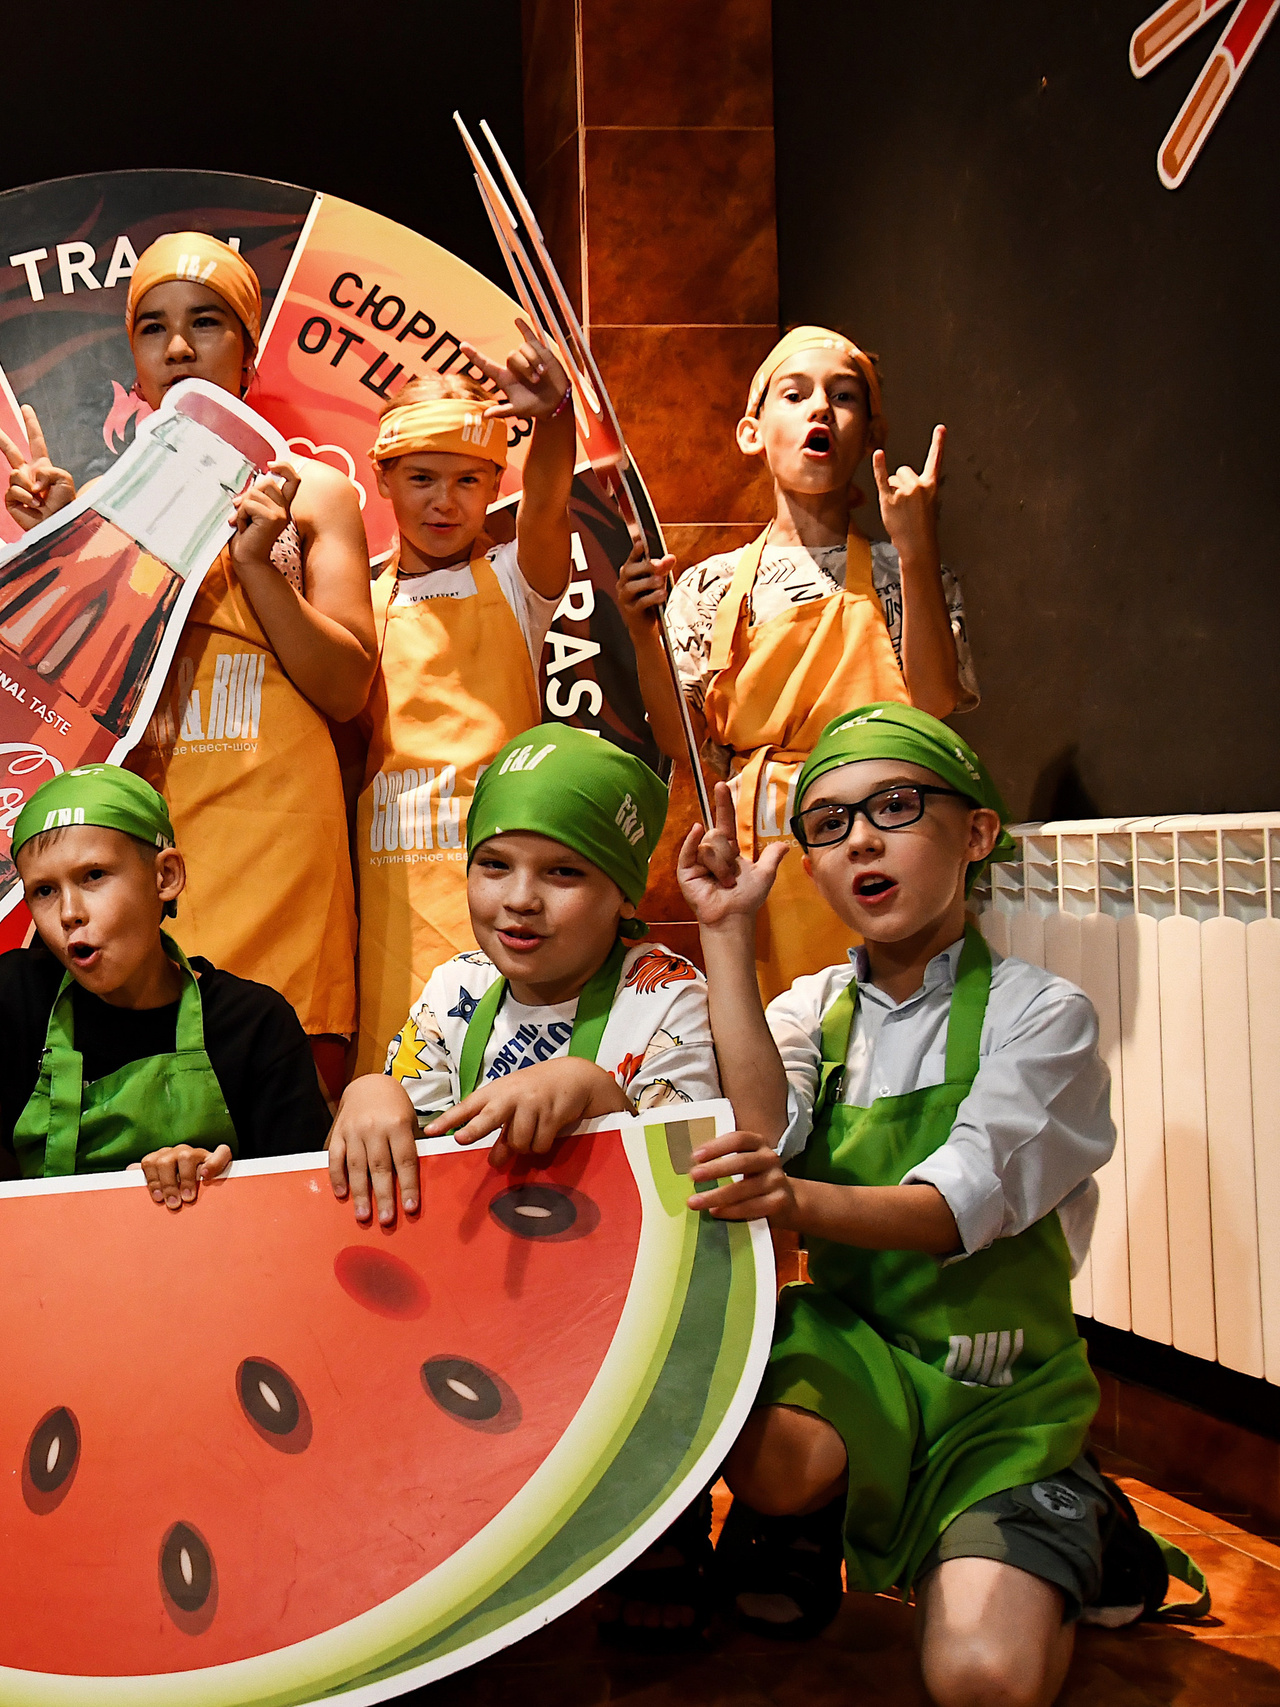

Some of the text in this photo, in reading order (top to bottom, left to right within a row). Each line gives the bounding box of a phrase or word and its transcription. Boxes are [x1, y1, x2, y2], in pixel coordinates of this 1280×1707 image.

[9, 233, 241, 302] TRA
[297, 316, 364, 368] ОТ
[328, 272, 533, 447] СЮРПЗ
[544, 531, 603, 737] RAS
[27, 696, 72, 736] TASTE
[207, 653, 266, 740] RUN
[437, 764, 462, 849] &
[370, 852, 444, 866] кулинарное
